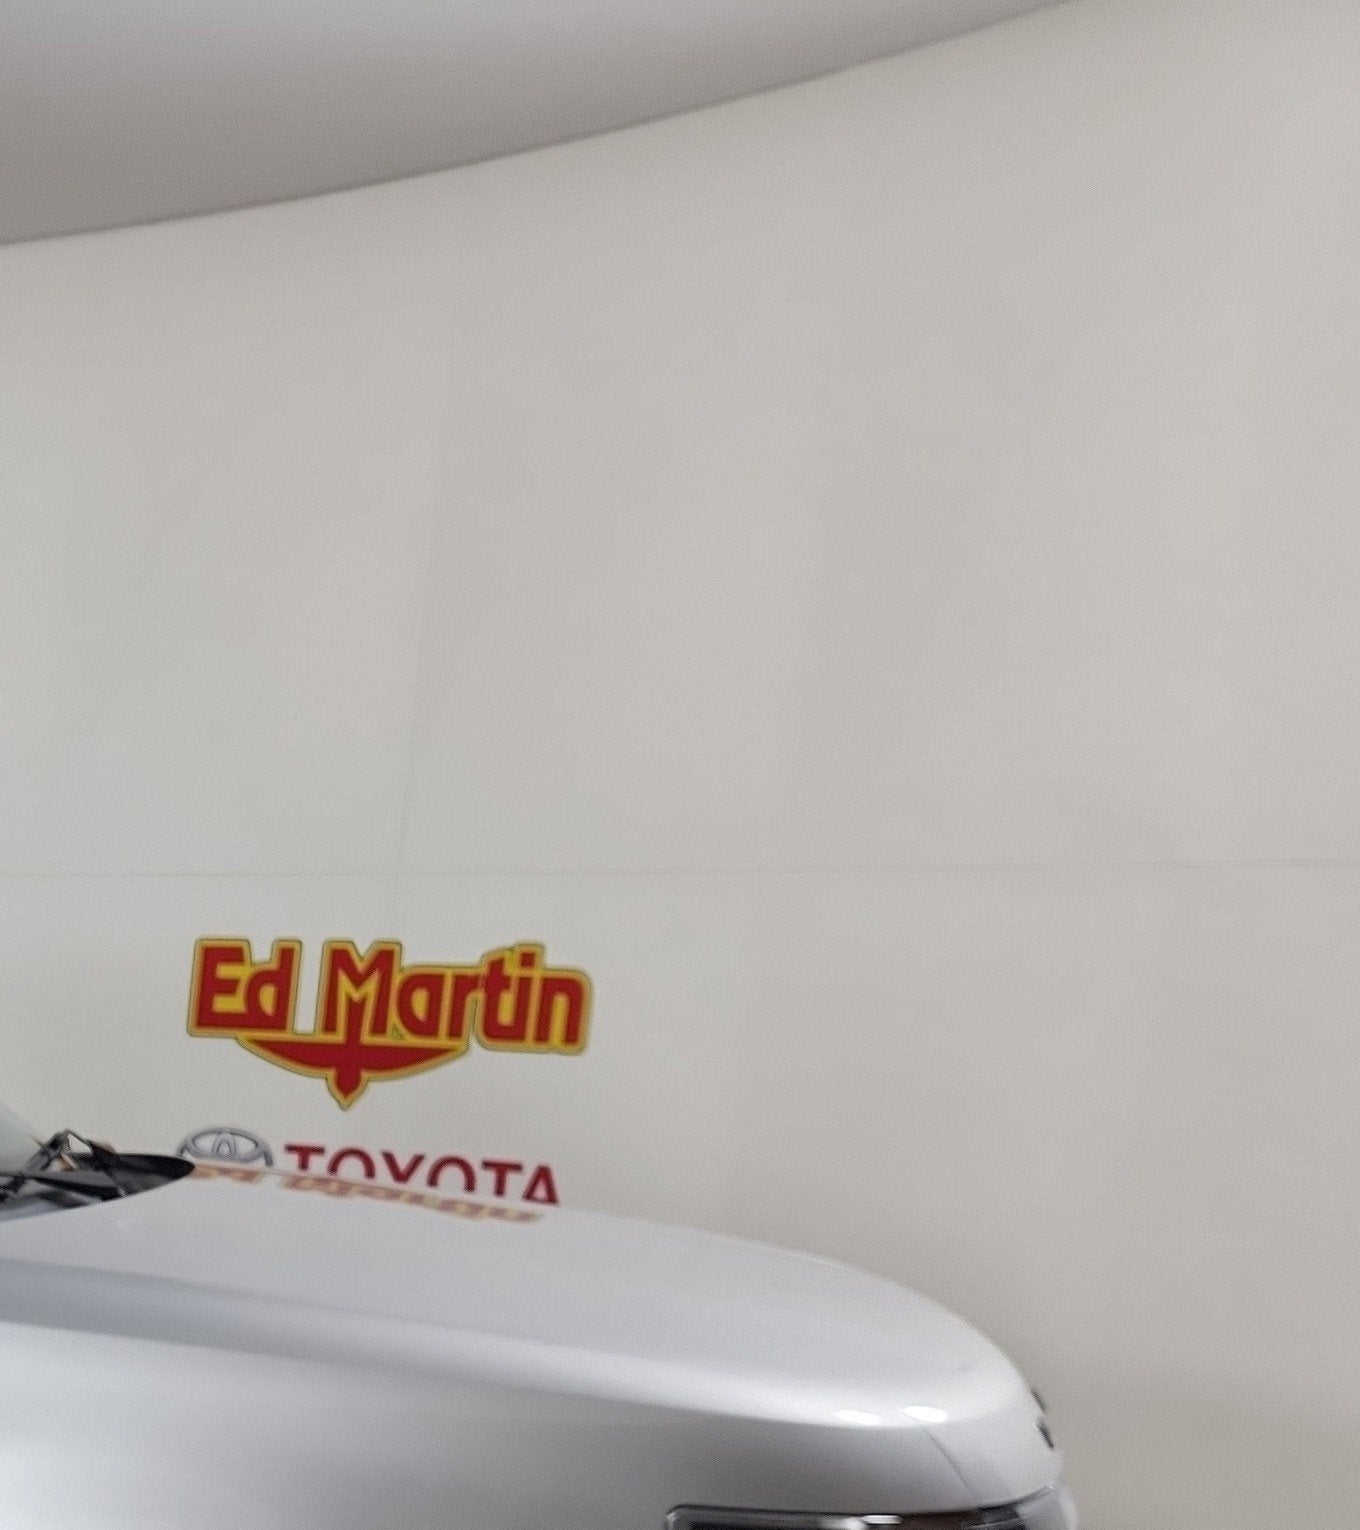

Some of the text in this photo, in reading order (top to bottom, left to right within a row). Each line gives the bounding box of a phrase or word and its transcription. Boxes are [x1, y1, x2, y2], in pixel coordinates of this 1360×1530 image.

[191, 941, 587, 1049] Ed Martin
[284, 1142, 560, 1205] TOYOTA
